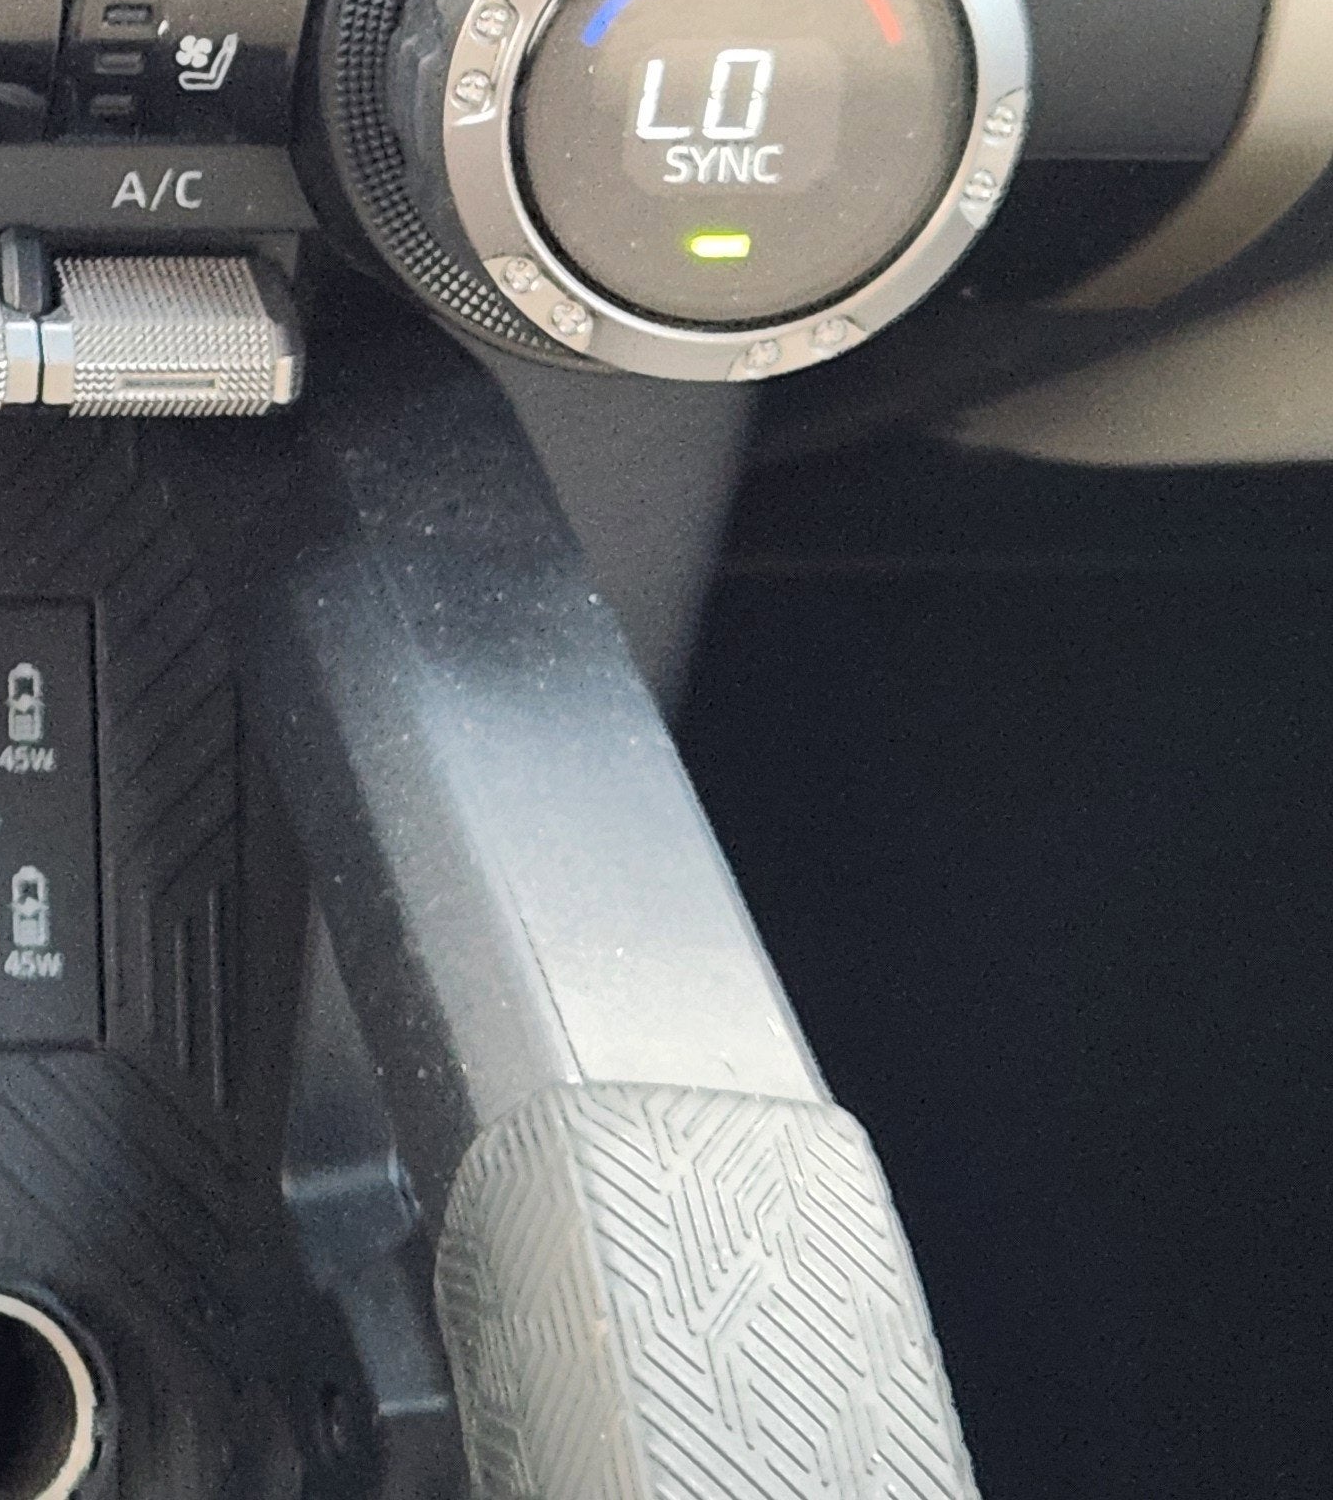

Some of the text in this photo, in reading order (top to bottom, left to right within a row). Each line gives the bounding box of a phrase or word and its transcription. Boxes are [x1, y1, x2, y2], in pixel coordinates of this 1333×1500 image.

[662, 143, 783, 184] SYNC
[112, 168, 204, 210] A/C
[3, 951, 64, 979] 45W
